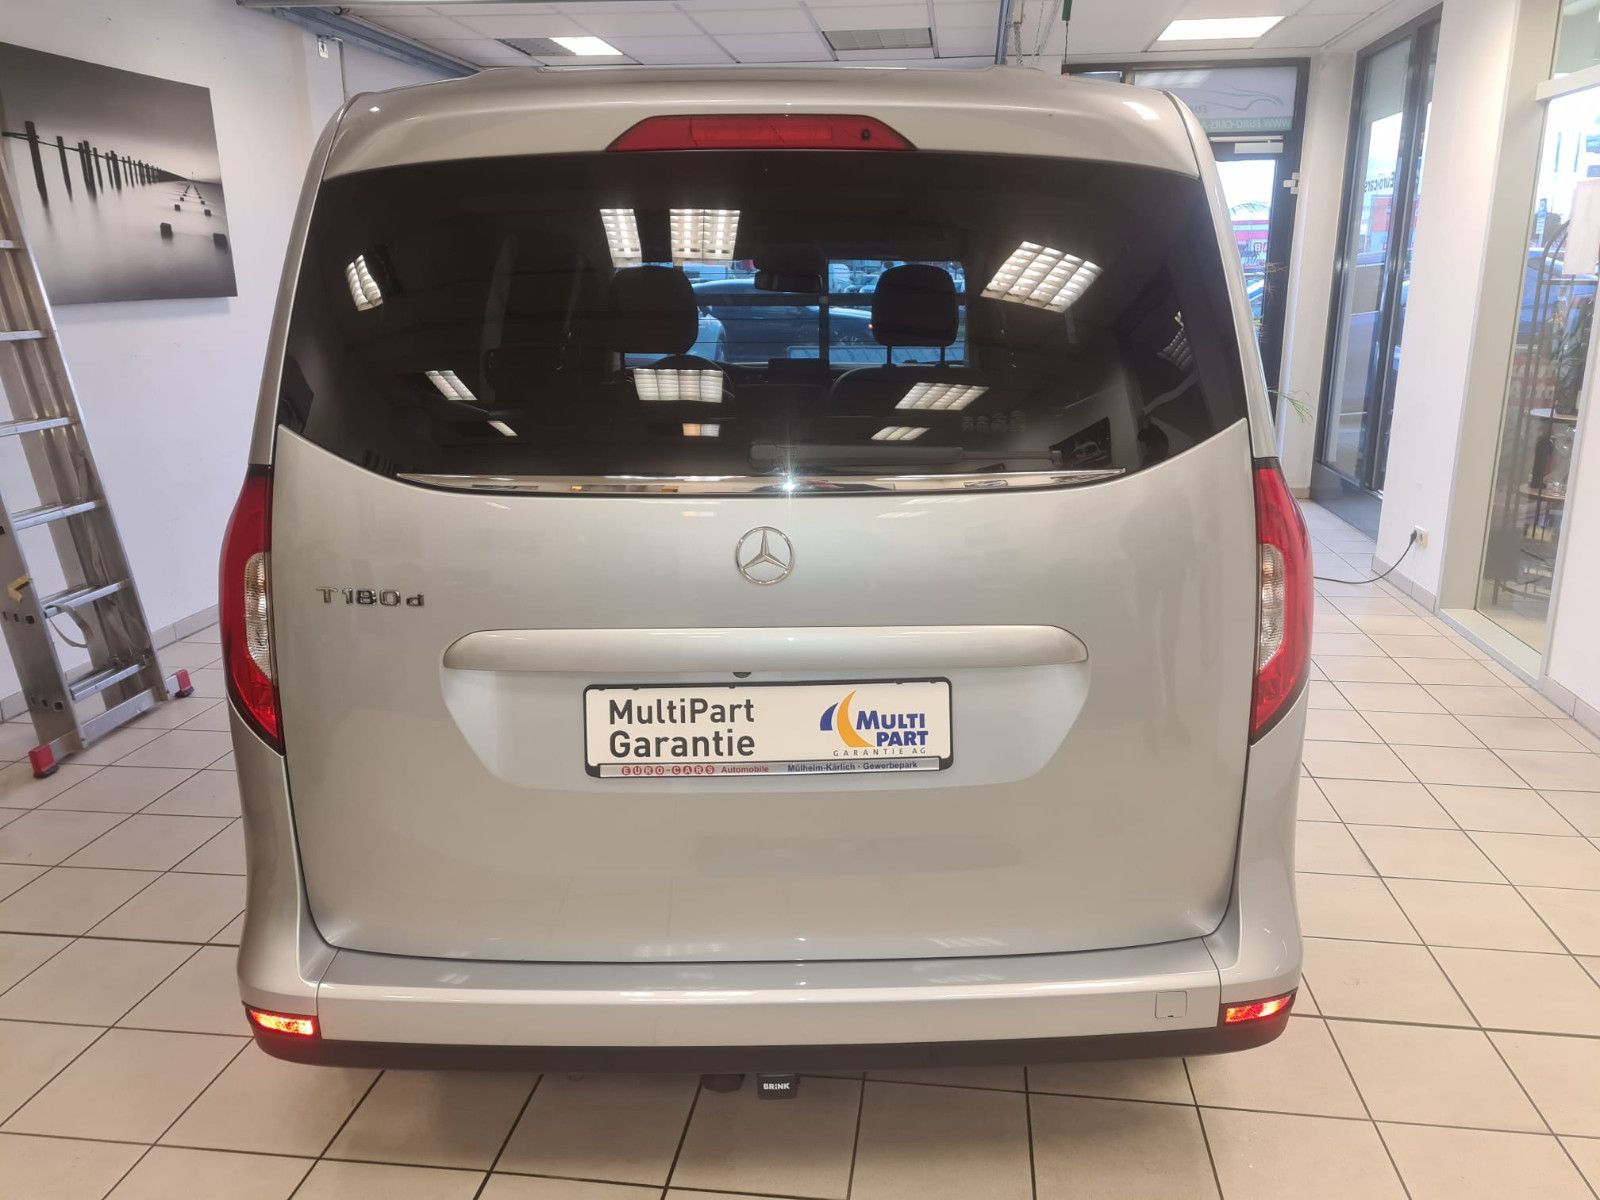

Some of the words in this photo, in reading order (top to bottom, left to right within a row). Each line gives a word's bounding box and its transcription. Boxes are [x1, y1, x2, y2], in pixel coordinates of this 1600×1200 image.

[608, 697, 755, 725] MultiPart
[856, 710, 926, 730] MULTI
[609, 728, 756, 758] Garantie
[876, 730, 929, 747] PART
[832, 748, 904, 757] GARANTIE
[911, 746, 927, 755] AG
[621, 764, 716, 776] EURO-CARS
[721, 764, 769, 774] Automobile
[862, 760, 919, 771] Gewerbepark
[763, 1082, 790, 1090] BRINK
